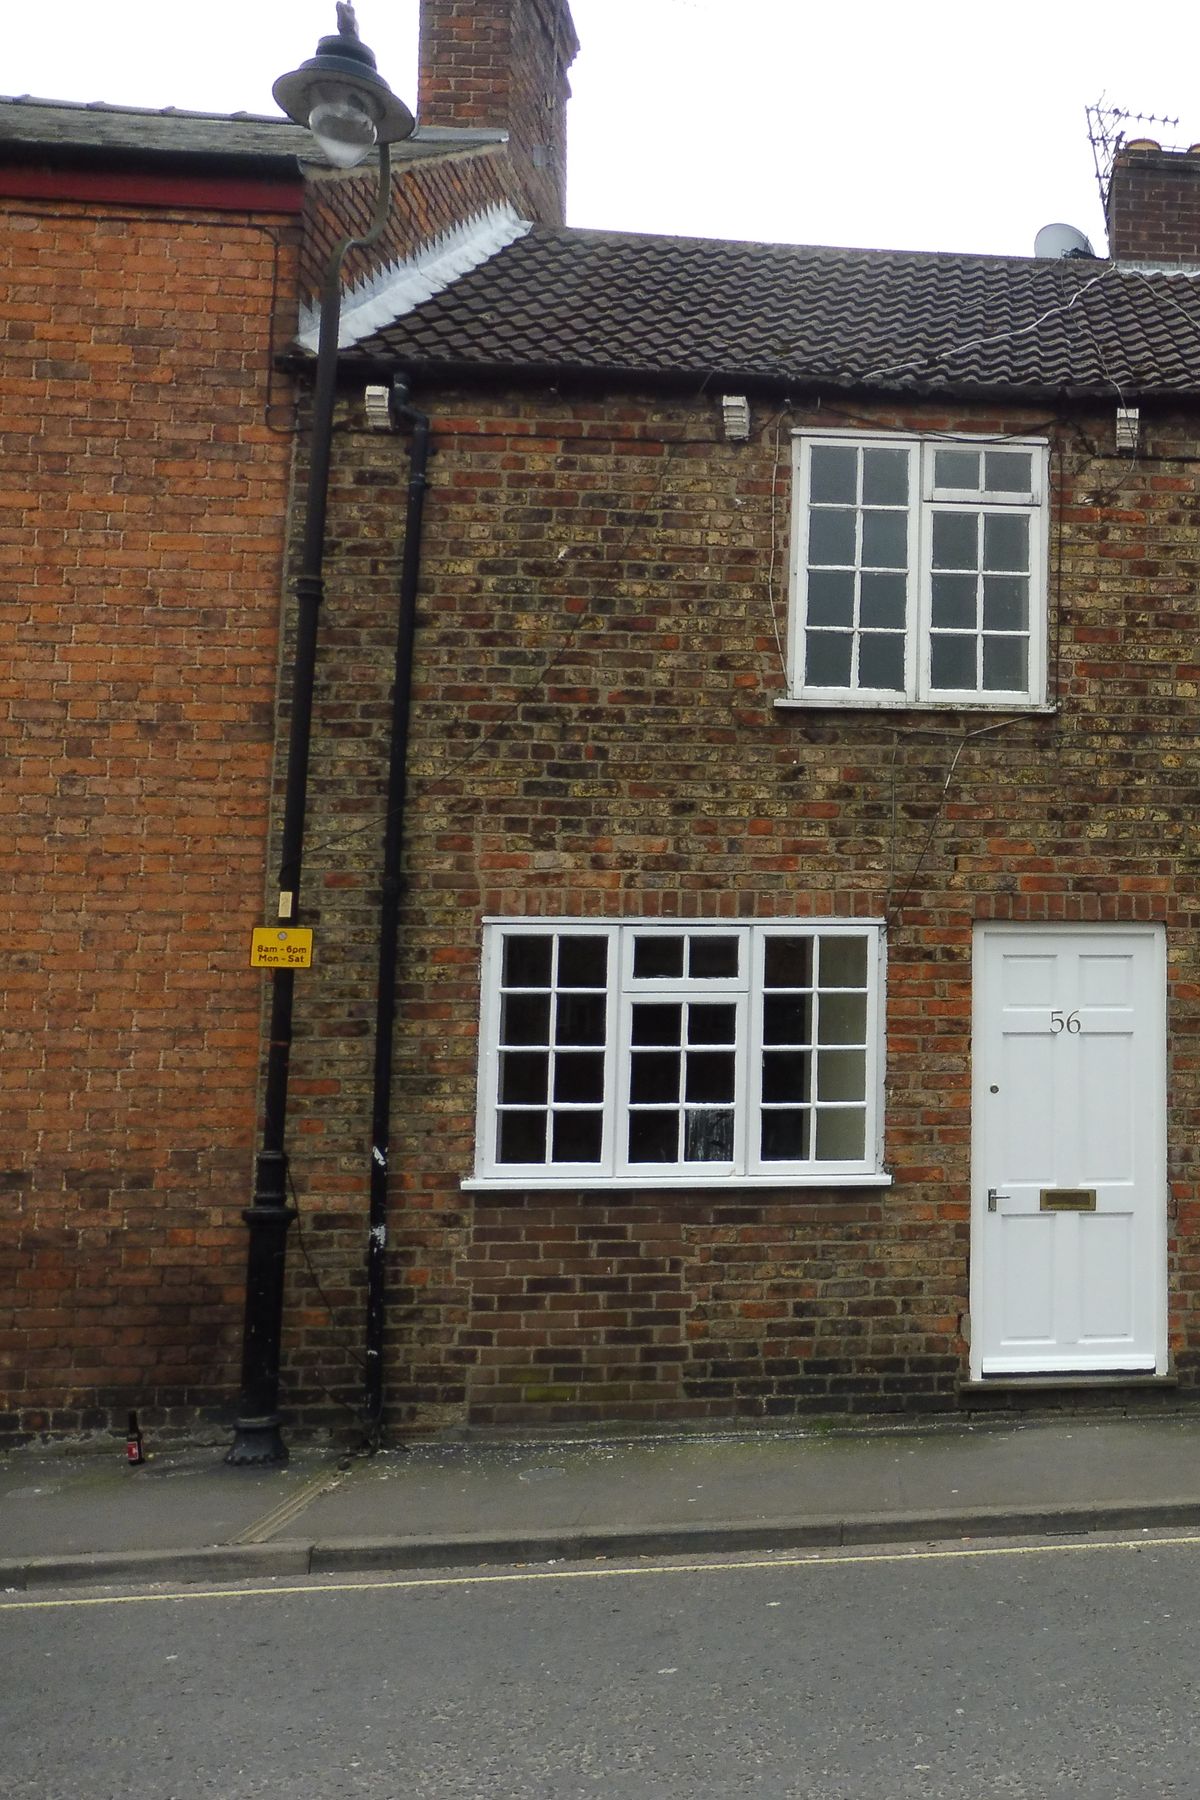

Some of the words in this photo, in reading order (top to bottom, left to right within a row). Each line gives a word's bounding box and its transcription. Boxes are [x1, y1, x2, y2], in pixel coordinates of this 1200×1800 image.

[257, 945, 278, 953] 8am
[286, 945, 307, 954] 6pm
[258, 954, 279, 962] Mon
[287, 954, 305, 963] Sat
[1049, 1010, 1081, 1034] 56
